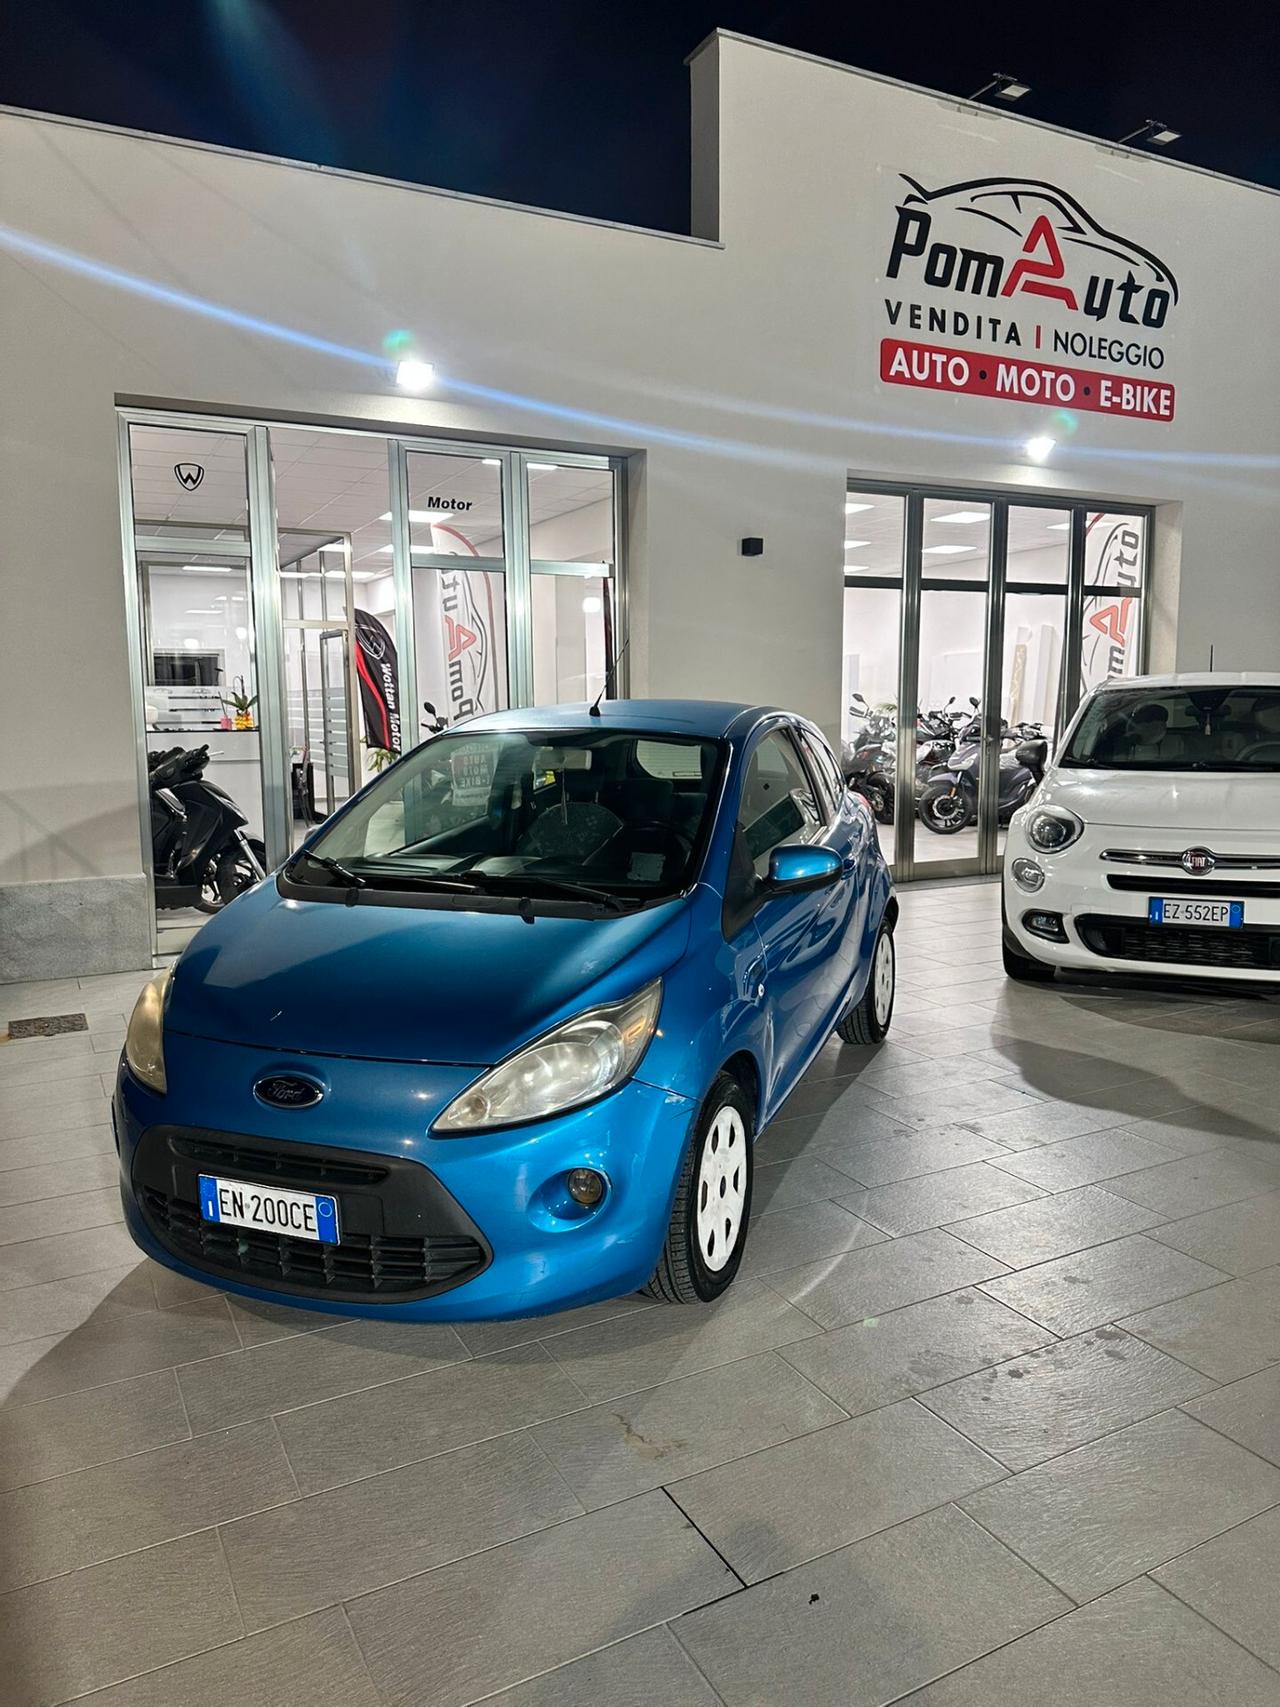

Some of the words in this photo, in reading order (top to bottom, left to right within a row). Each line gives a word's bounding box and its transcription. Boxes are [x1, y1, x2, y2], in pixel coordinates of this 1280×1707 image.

[886, 205, 1170, 328] PomAuto
[885, 299, 1021, 346] VENDITA
[1053, 329, 1164, 369] NOLEGGIO
[889, 347, 970, 386] AUTO
[996, 364, 1075, 401] MOTO
[1100, 379, 1171, 416] E-BIKE
[427, 496, 473, 511] Motor
[380, 662, 396, 709] Wottan
[389, 713, 401, 751] Motor
[268, 1080, 306, 1101] Ford
